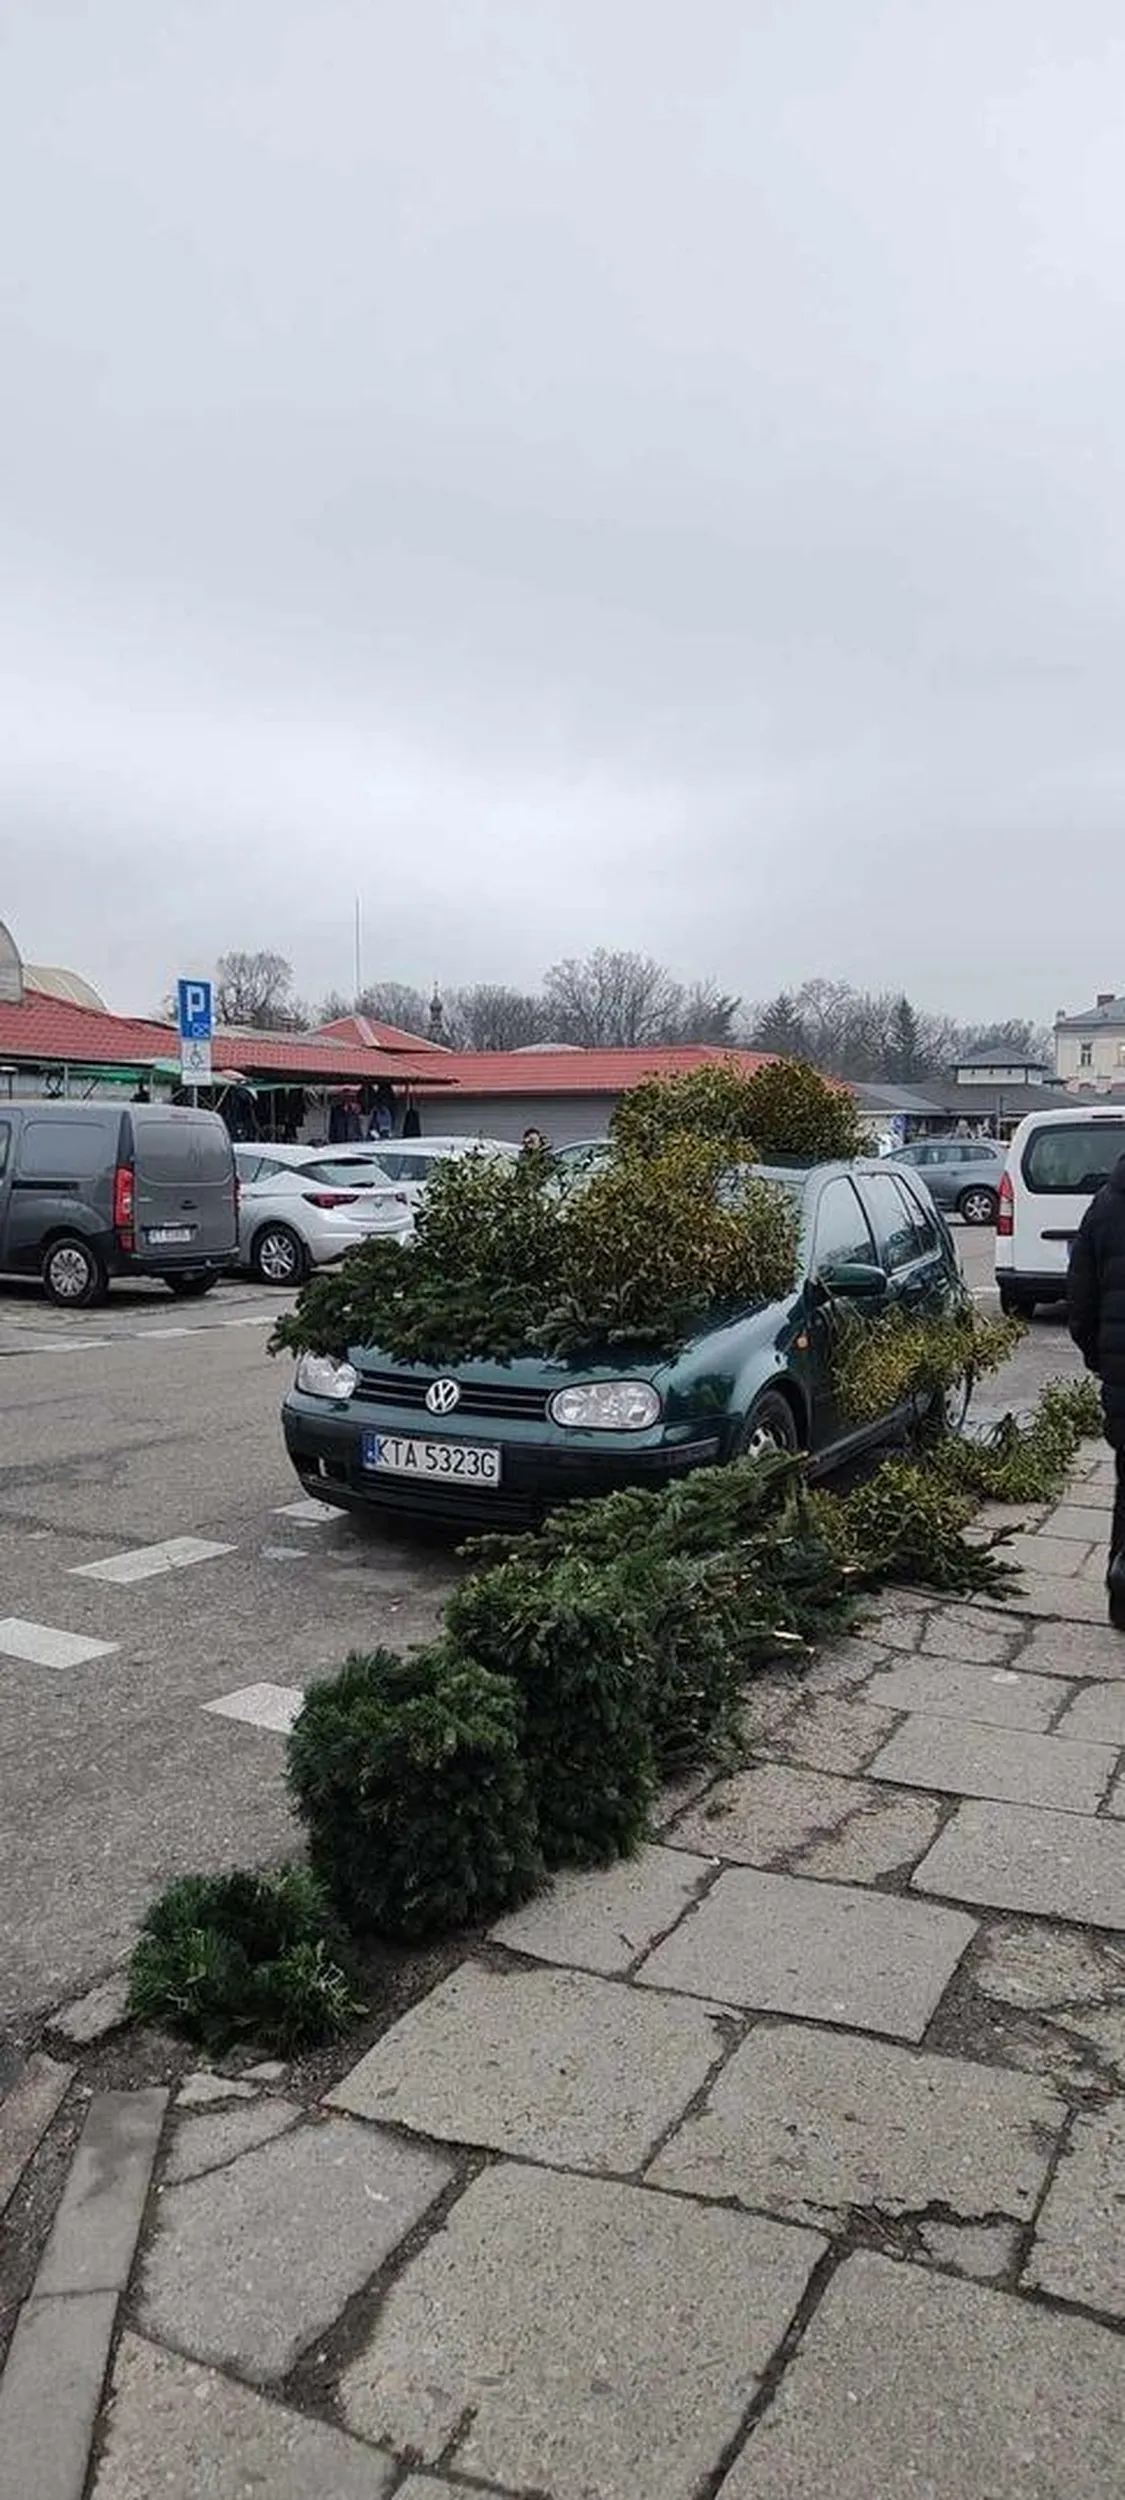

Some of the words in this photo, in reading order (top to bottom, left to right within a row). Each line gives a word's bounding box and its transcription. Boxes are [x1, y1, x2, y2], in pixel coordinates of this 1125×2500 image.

[187, 986, 205, 1022] P
[426, 1379, 459, 1413] VW
[377, 1438, 418, 1468] KTA
[425, 1444, 496, 1478] 5323G
